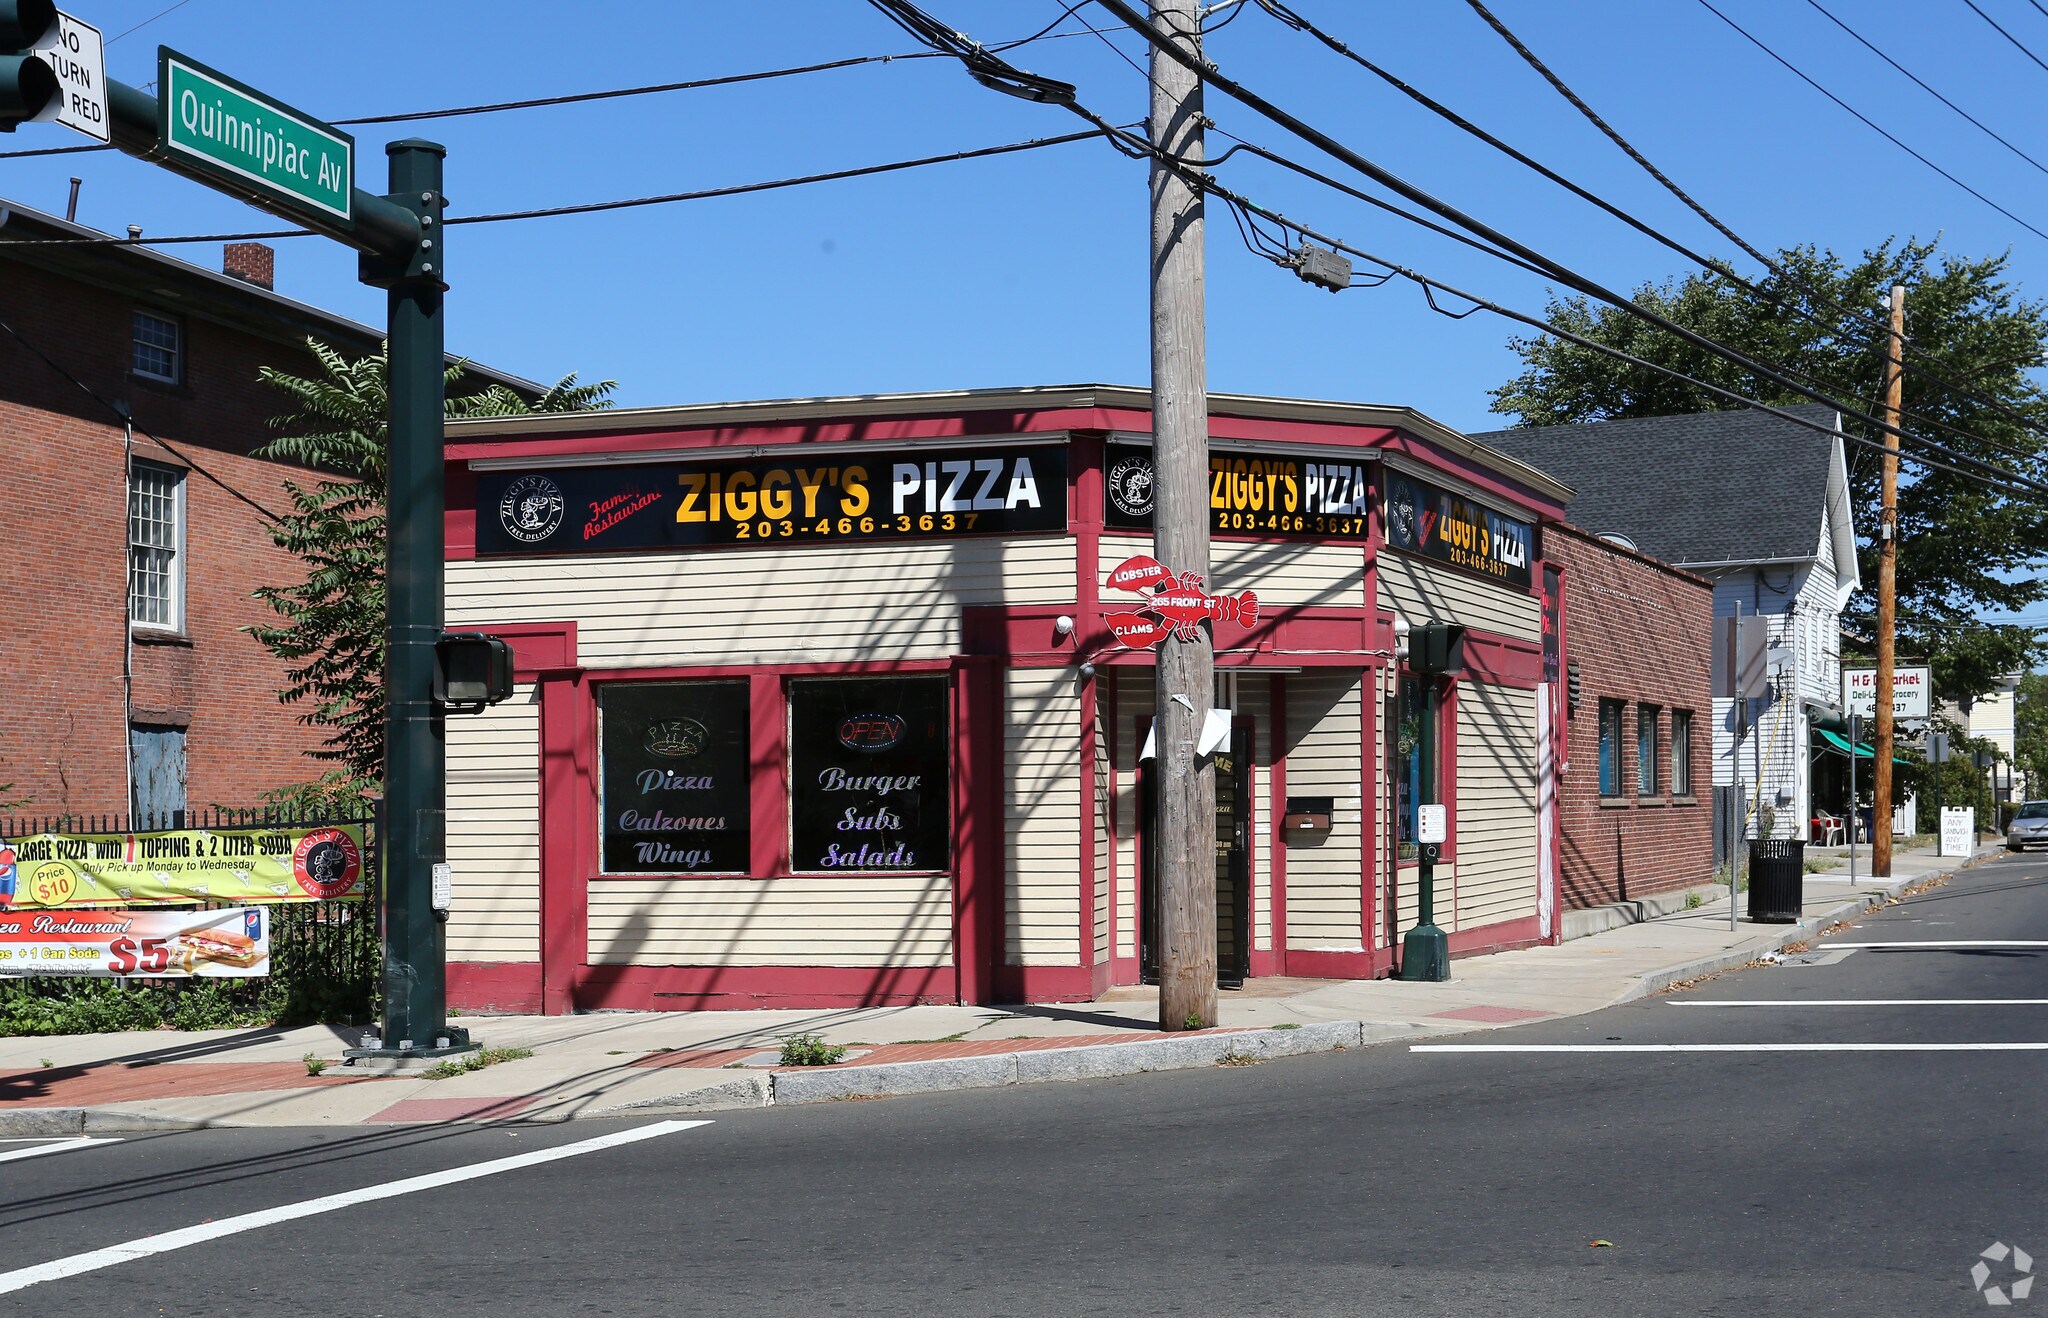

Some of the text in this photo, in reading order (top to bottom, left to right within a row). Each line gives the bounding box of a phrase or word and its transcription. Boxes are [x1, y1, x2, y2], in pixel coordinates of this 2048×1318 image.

[57, 28, 80, 53] NO
[49, 51, 91, 89] TURN
[72, 92, 102, 123] RED
[180, 89, 342, 193] Quinnipiac Av
[1110, 458, 1141, 491] ZIGGY'S
[1210, 457, 1298, 513] ZIGGY'S
[1305, 463, 1367, 516] PIZZA
[502, 477, 562, 518] ZIGGY'S PIZZA
[676, 457, 1041, 523] ZIGGY'S PIZZA
[583, 485, 663, 541] Restaurant
[1115, 498, 1129, 511] FREE
[509, 520, 557, 540] FREE DELIVERY
[735, 513, 979, 539] 203-466-3637
[1218, 512, 1363, 534] 203-466-3637
[1440, 495, 1490, 557] ZIGGY'S
[1493, 518, 1526, 570] PIZZA
[1114, 565, 1163, 583] LOBSTER
[1450, 547, 1508, 578] 203-466-3637
[1151, 596, 1216, 609] 265 FRONT ST
[1115, 624, 1154, 636] CLAMS
[1852, 674, 1860, 686] H
[1862, 674, 1871, 686] &
[1892, 672, 1920, 685] arket
[648, 721, 703, 743] PIZZA
[839, 721, 901, 741] OPEN
[636, 768, 715, 795] Pizza
[818, 766, 922, 797] Burger
[618, 809, 728, 832] Calzones
[836, 806, 904, 831] Subs
[16, 834, 292, 863] LARGE PIZZA with 1 TOPPING & 2 LITER SODA
[295, 830, 357, 871] ZIGGY'S PIZZA
[632, 841, 714, 869] Wings
[819, 843, 917, 868] Salads
[37, 867, 65, 882] Price
[82, 859, 257, 875] Only Pick up Monday to Wednesday
[38, 878, 69, 900] $10
[302, 876, 352, 896] FREE DELIVERY
[29, 915, 133, 934] Restaurant
[30, 947, 38, 959] 1
[41, 947, 66, 960] Can
[69, 947, 100, 960] Soda
[108, 936, 170, 977] $5
